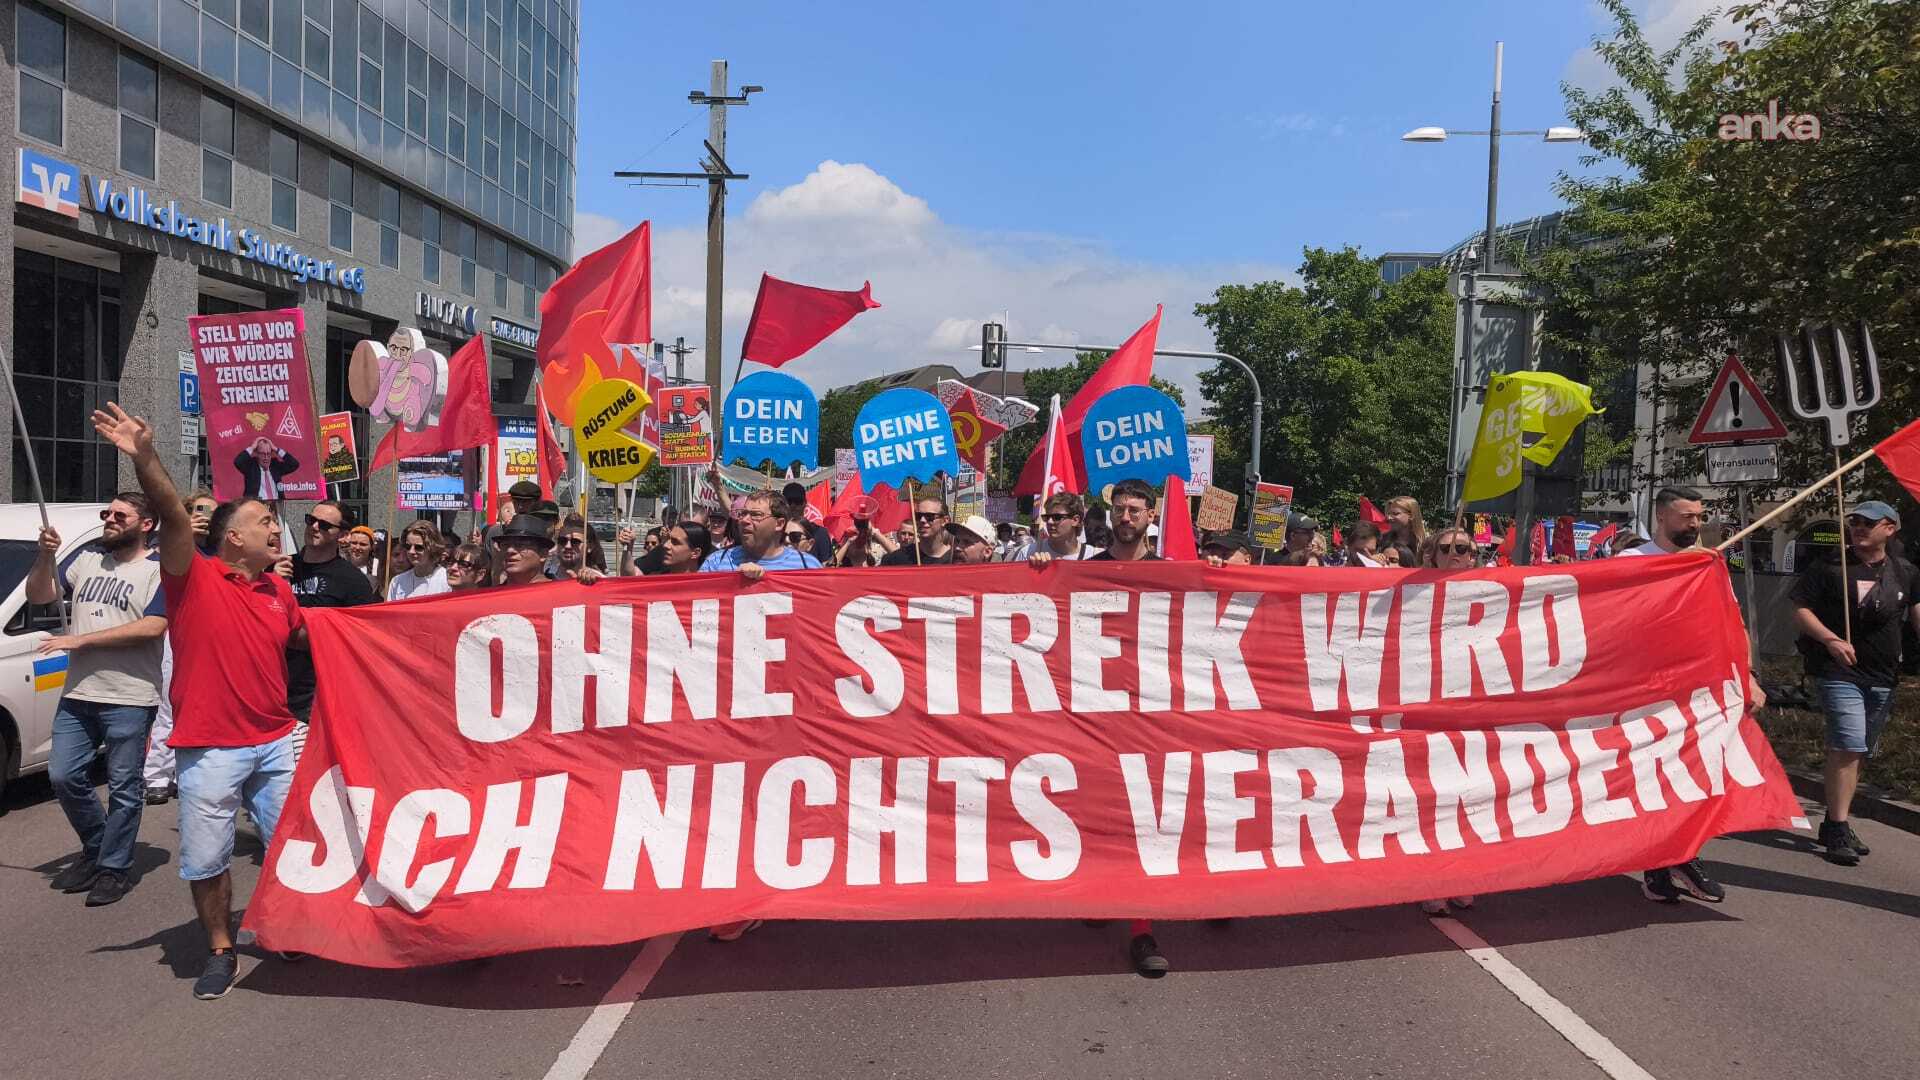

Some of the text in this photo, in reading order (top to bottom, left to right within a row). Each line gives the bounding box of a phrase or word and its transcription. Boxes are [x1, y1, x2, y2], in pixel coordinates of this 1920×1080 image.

[84, 173, 366, 295] Volksbank Stuttgart eG
[198, 320, 295, 344] STELL DIR VOR
[200, 346, 231, 365] WIR
[232, 341, 294, 362] WÜRDEN
[215, 363, 290, 384] ZEITGLEICH
[184, 379, 195, 408] P
[221, 384, 290, 405] STREIKEN!
[582, 388, 637, 440] RÜSTUNG
[735, 398, 803, 420] DEIN
[505, 425, 537, 434] IM KIN
[729, 426, 809, 446] LEBEN
[860, 409, 940, 445] DEINE
[1095, 409, 1164, 441] DEIN
[588, 445, 640, 469] KRIEG
[863, 435, 947, 469] RENTE
[1095, 435, 1174, 469] LOHN
[1710, 456, 1776, 469] Veranstaltung
[400, 482, 423, 491] ODER
[76, 576, 134, 612] ADIDAS
[455, 573, 1588, 743] OHNE STREIK WIRD
[603, 752, 1082, 890] NICHTS
[1119, 663, 1764, 876] VERÄNDERN
